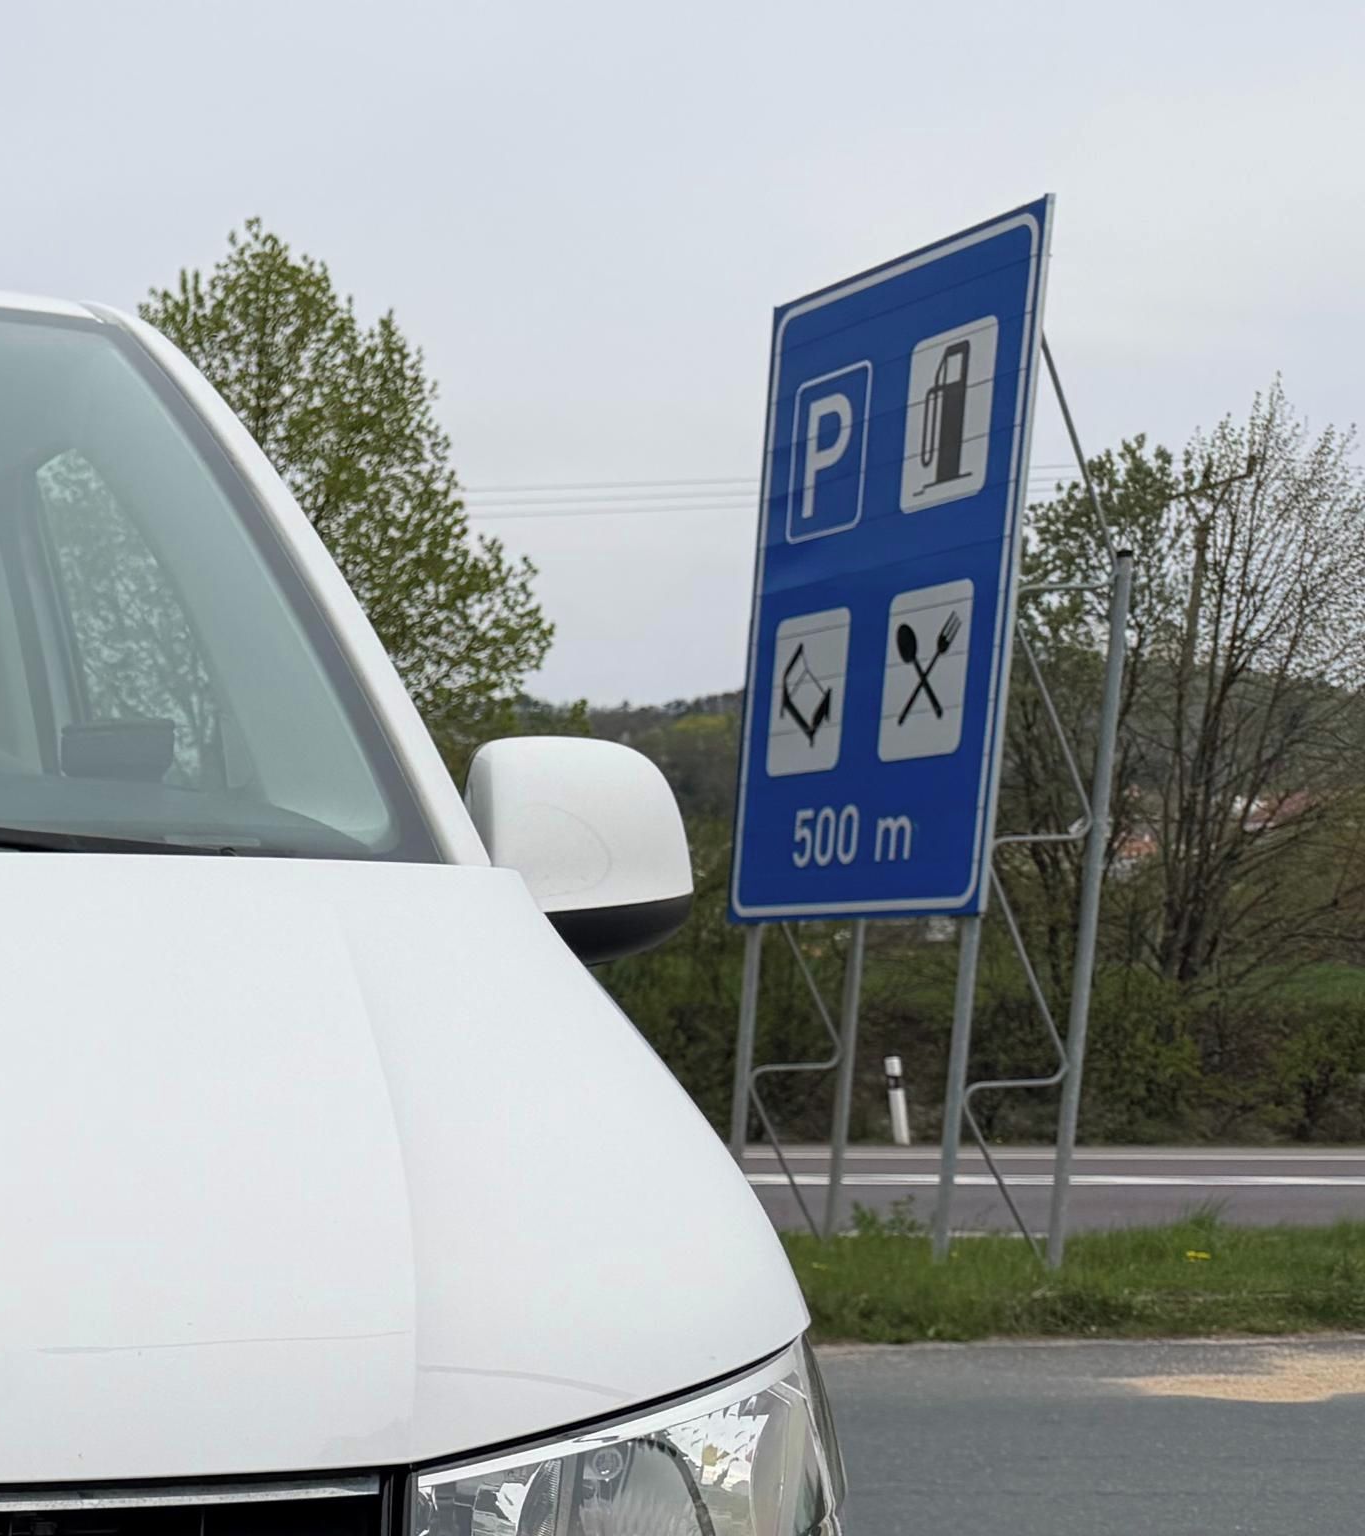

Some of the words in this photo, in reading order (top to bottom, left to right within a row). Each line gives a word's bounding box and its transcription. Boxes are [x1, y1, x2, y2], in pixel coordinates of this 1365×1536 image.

[800, 391, 854, 519] P
[792, 804, 859, 868] 500
[874, 815, 912, 862] m
